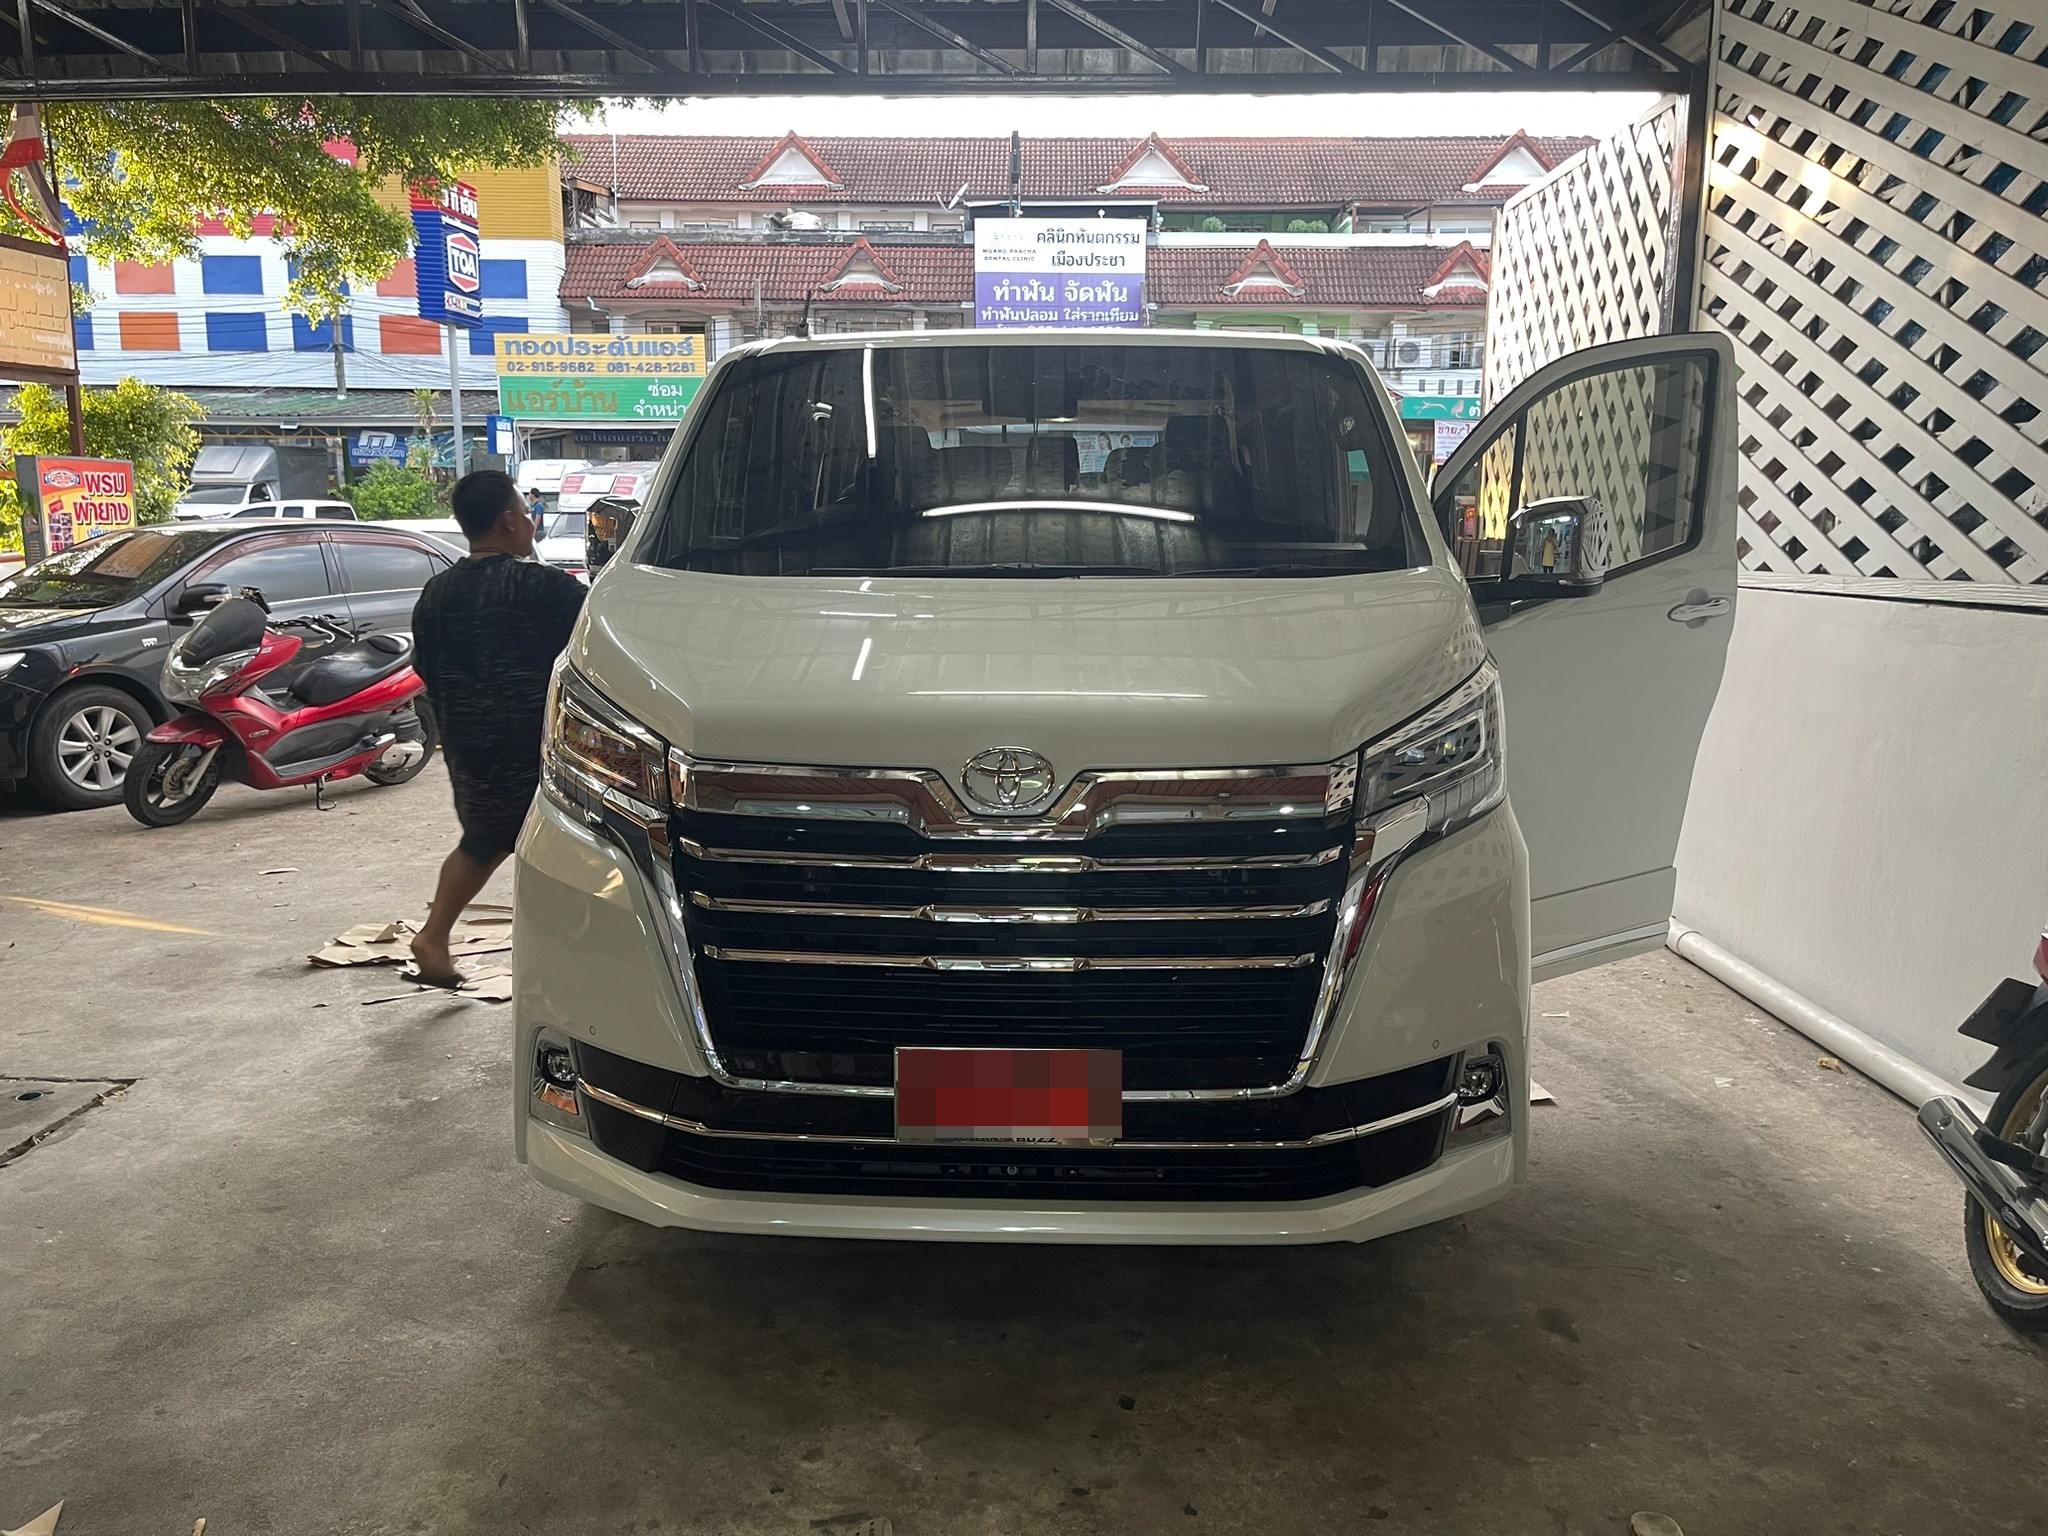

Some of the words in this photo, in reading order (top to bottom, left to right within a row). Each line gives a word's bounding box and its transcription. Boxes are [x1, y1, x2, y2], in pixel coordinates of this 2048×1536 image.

[1036, 228, 1140, 245] คลินิกทันตกรรม
[451, 249, 477, 277] TOA
[1051, 250, 1126, 267] เมืองประชา
[993, 278, 1055, 302] ทำฟัน
[1064, 280, 1128, 303] จัดฟัน
[981, 306, 1059, 321] ทำฟันปลอม
[1063, 307, 1139, 322] ใส่รากเทียม
[503, 335, 695, 357] ทองประดับแอร์
[506, 361, 596, 373] 02-915-9682
[606, 362, 696, 373] 081-428-1281
[506, 378, 619, 414] แอร์บ้าน
[647, 378, 683, 397] ซ่อม
[633, 399, 691, 417] จำหน่า
[83, 472, 128, 497] พรม
[72, 494, 131, 525] ผ้ายาง
